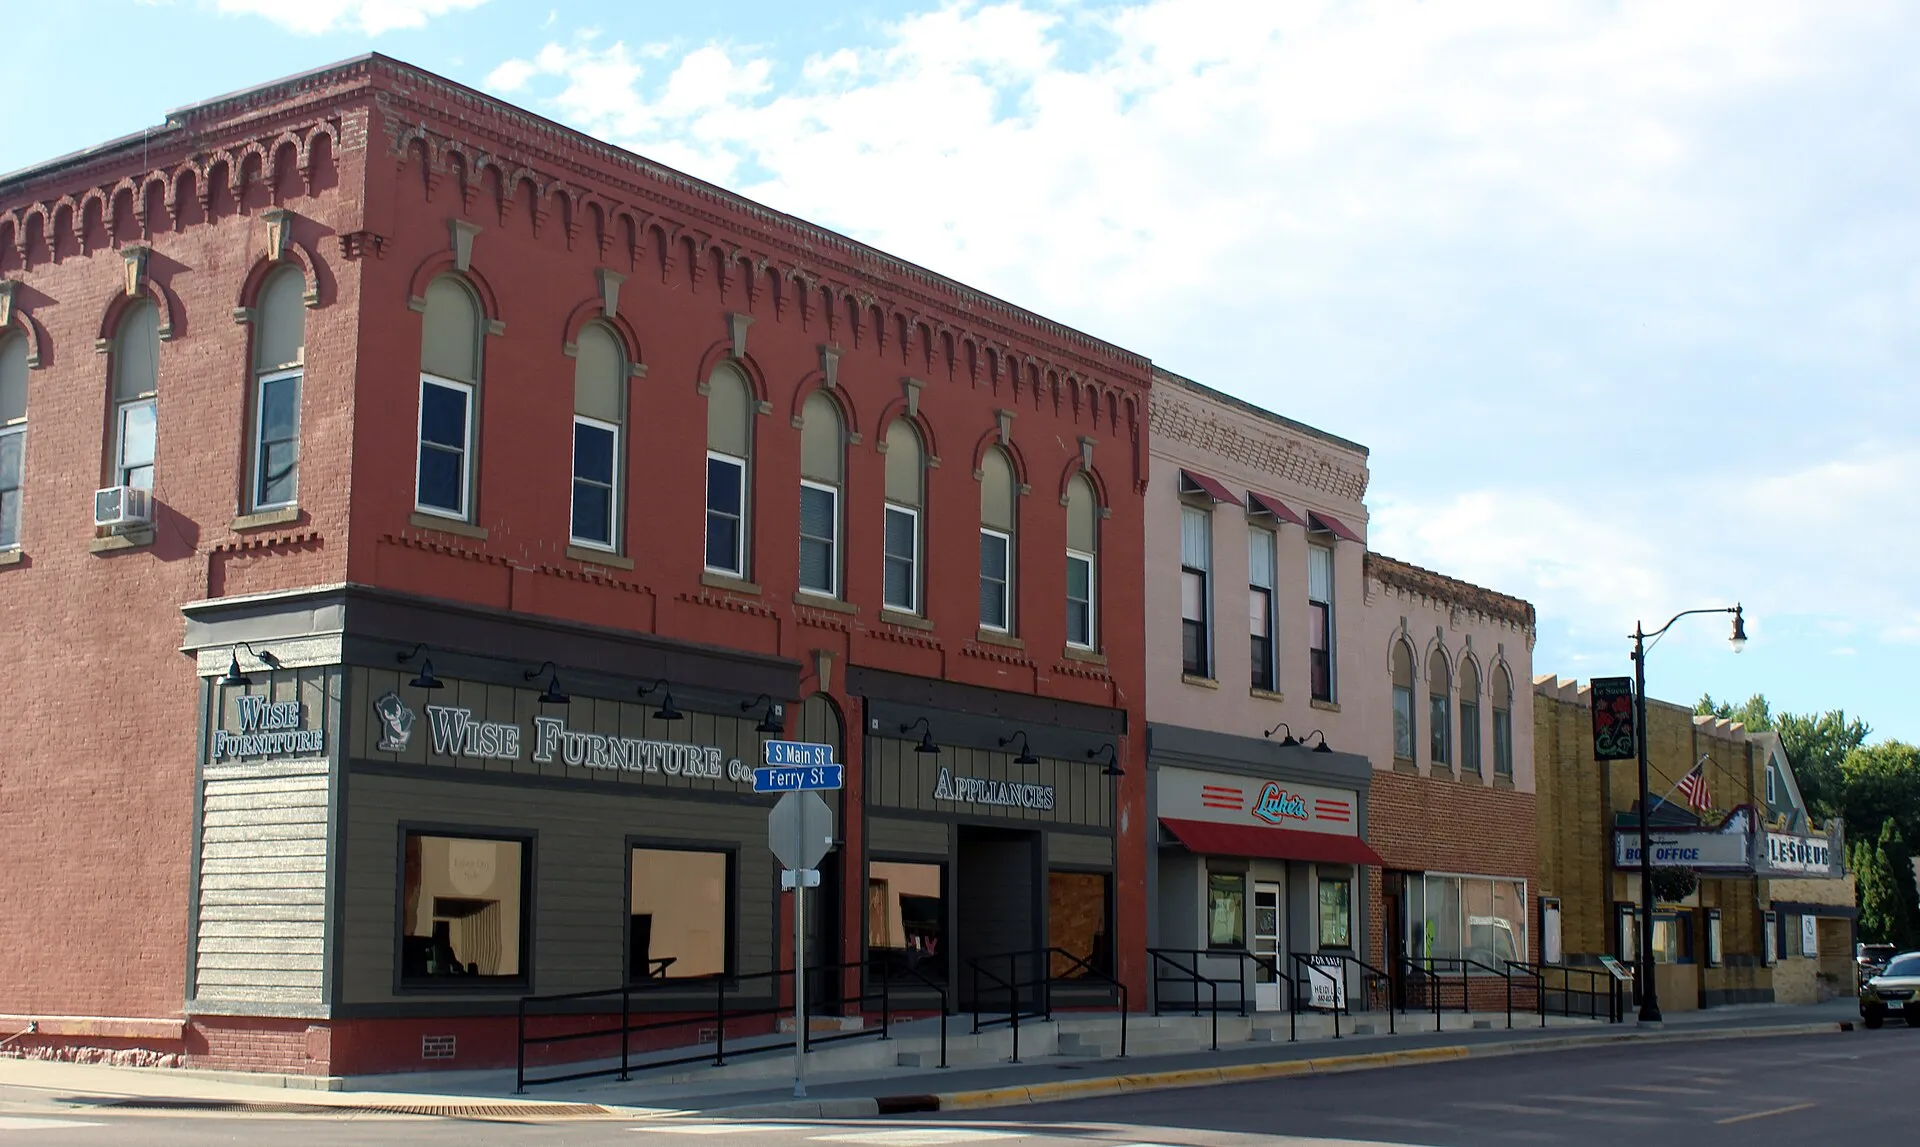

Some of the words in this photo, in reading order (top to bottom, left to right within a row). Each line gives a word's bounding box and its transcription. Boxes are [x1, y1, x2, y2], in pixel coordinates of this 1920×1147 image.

[236, 695, 299, 731] WISE
[212, 729, 323, 758] FURNITURE
[426, 705, 520, 760] WISE
[533, 717, 722, 779] FURNITURE
[775, 743, 783, 762] S
[786, 745, 811, 764] Main
[814, 747, 825, 765] St
[769, 769, 804, 790] Ferry
[810, 767, 825, 785] St
[934, 766, 1055, 810] APPLIANCES
[1253, 782, 1308, 824] Luke's
[1655, 848, 1700, 860] OFFICE
[1310, 955, 1326, 965] FOR
